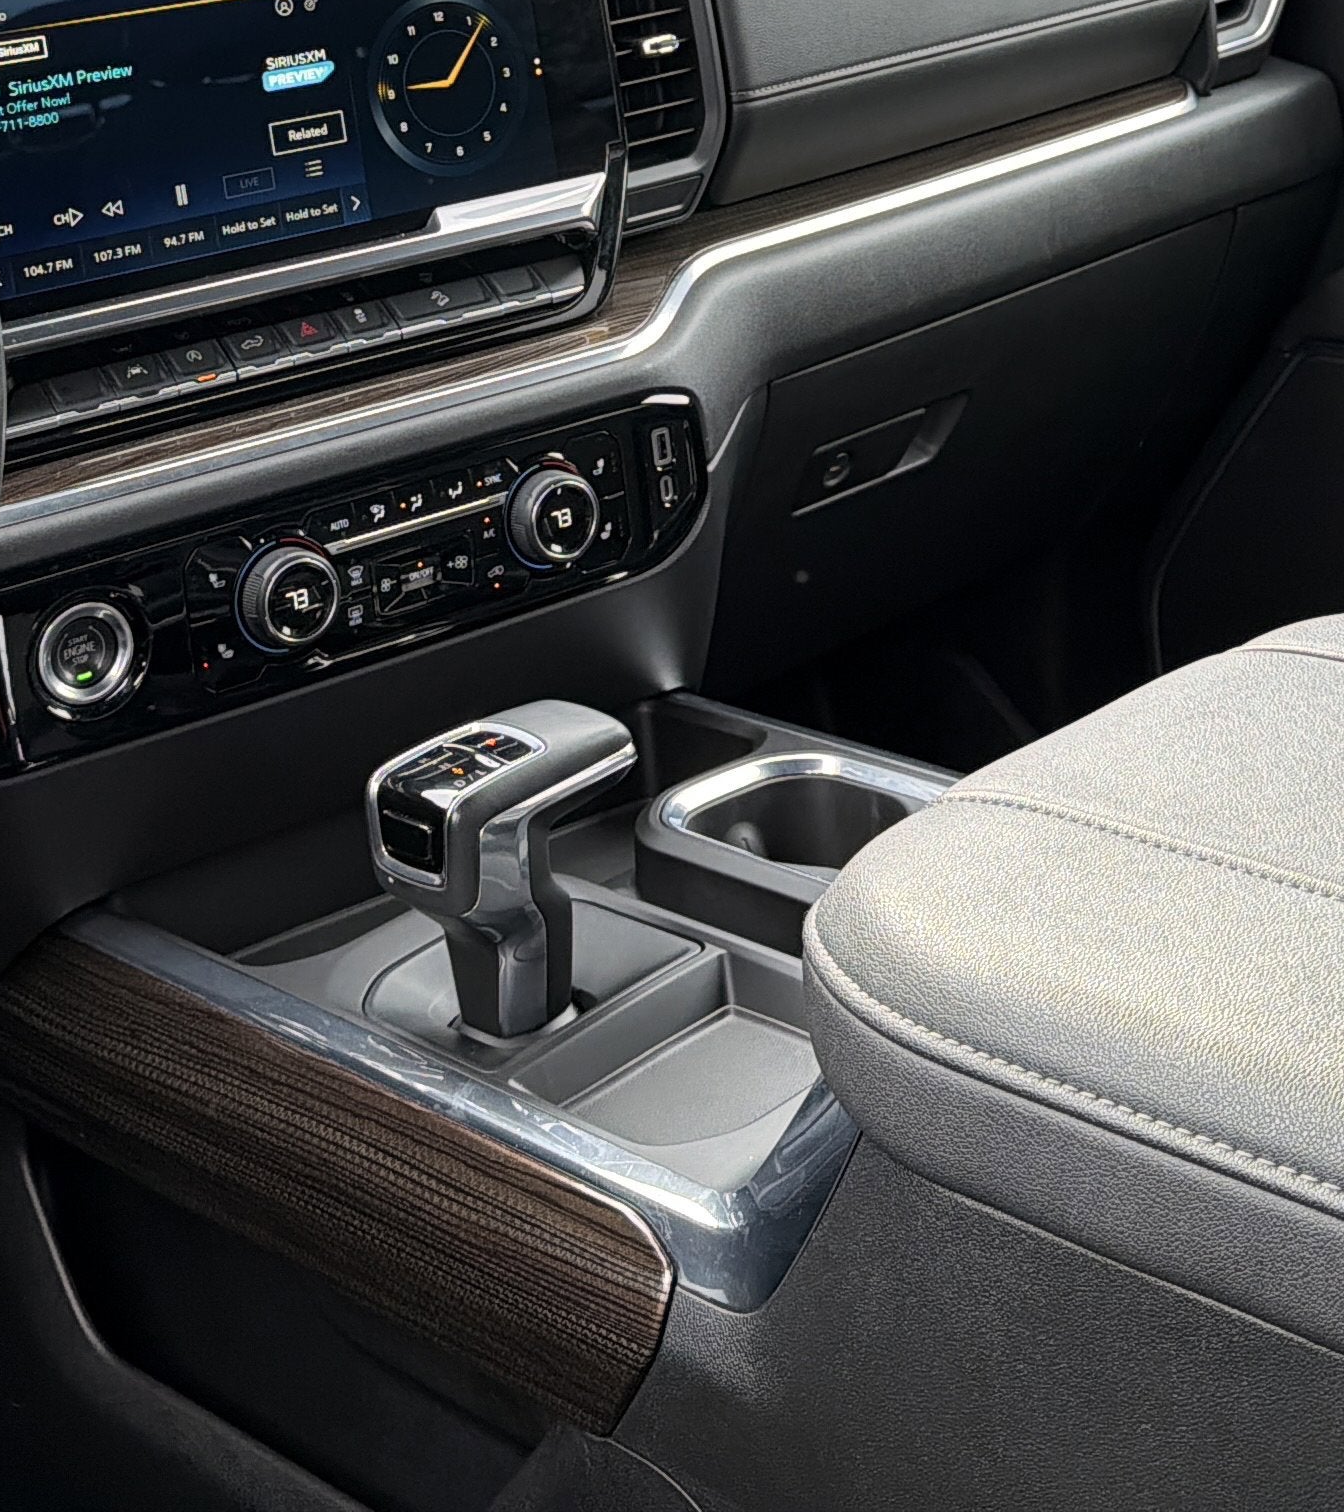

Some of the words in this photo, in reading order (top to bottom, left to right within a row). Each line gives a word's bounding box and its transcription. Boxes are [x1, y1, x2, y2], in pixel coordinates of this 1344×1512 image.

[433, 11, 444, 22] 12
[466, 16, 472, 26] 1
[407, 25, 416, 37] 11
[490, 37, 498, 47] 2
[265, 48, 327, 71] SIRIUSXM
[387, 54, 399, 65] 10
[267, 66, 329, 87] PREVIEW
[503, 67, 511, 78] 3
[8, 72, 74, 97] SiriusXM
[76, 65, 133, 84] Preview
[388, 89, 396, 100] 9
[6, 101, 38, 115] Offer
[41, 93, 72, 107] Now!
[499, 102, 507, 112] 4
[287, 123, 329, 142] Related
[400, 121, 408, 133] 8
[483, 131, 491, 142] 5
[425, 142, 433, 153] 7
[456, 145, 464, 157] 6
[239, 176, 259, 189] LIVE
[53, 212, 70, 226] CH
[285, 209, 309, 223] Hold
[310, 208, 321, 218] to
[322, 203, 339, 215] Set
[221, 221, 246, 236] Hold
[247, 220, 258, 231] to
[259, 216, 277, 228] Set
[163, 233, 187, 249] 94.7
[188, 230, 205, 243] FM
[93, 247, 123, 264] 107.3
[124, 243, 142, 257] FM
[23, 261, 54, 278] 104.7
[56, 258, 74, 272] FM
[483, 473, 503, 486] SYNC
[329, 518, 350, 532] AUTO
[482, 528, 496, 540] A/C
[408, 566, 435, 582] ON/OFF
[67, 634, 88, 647] START
[63, 640, 96, 661] ENGINE
[72, 653, 90, 664] STOP
